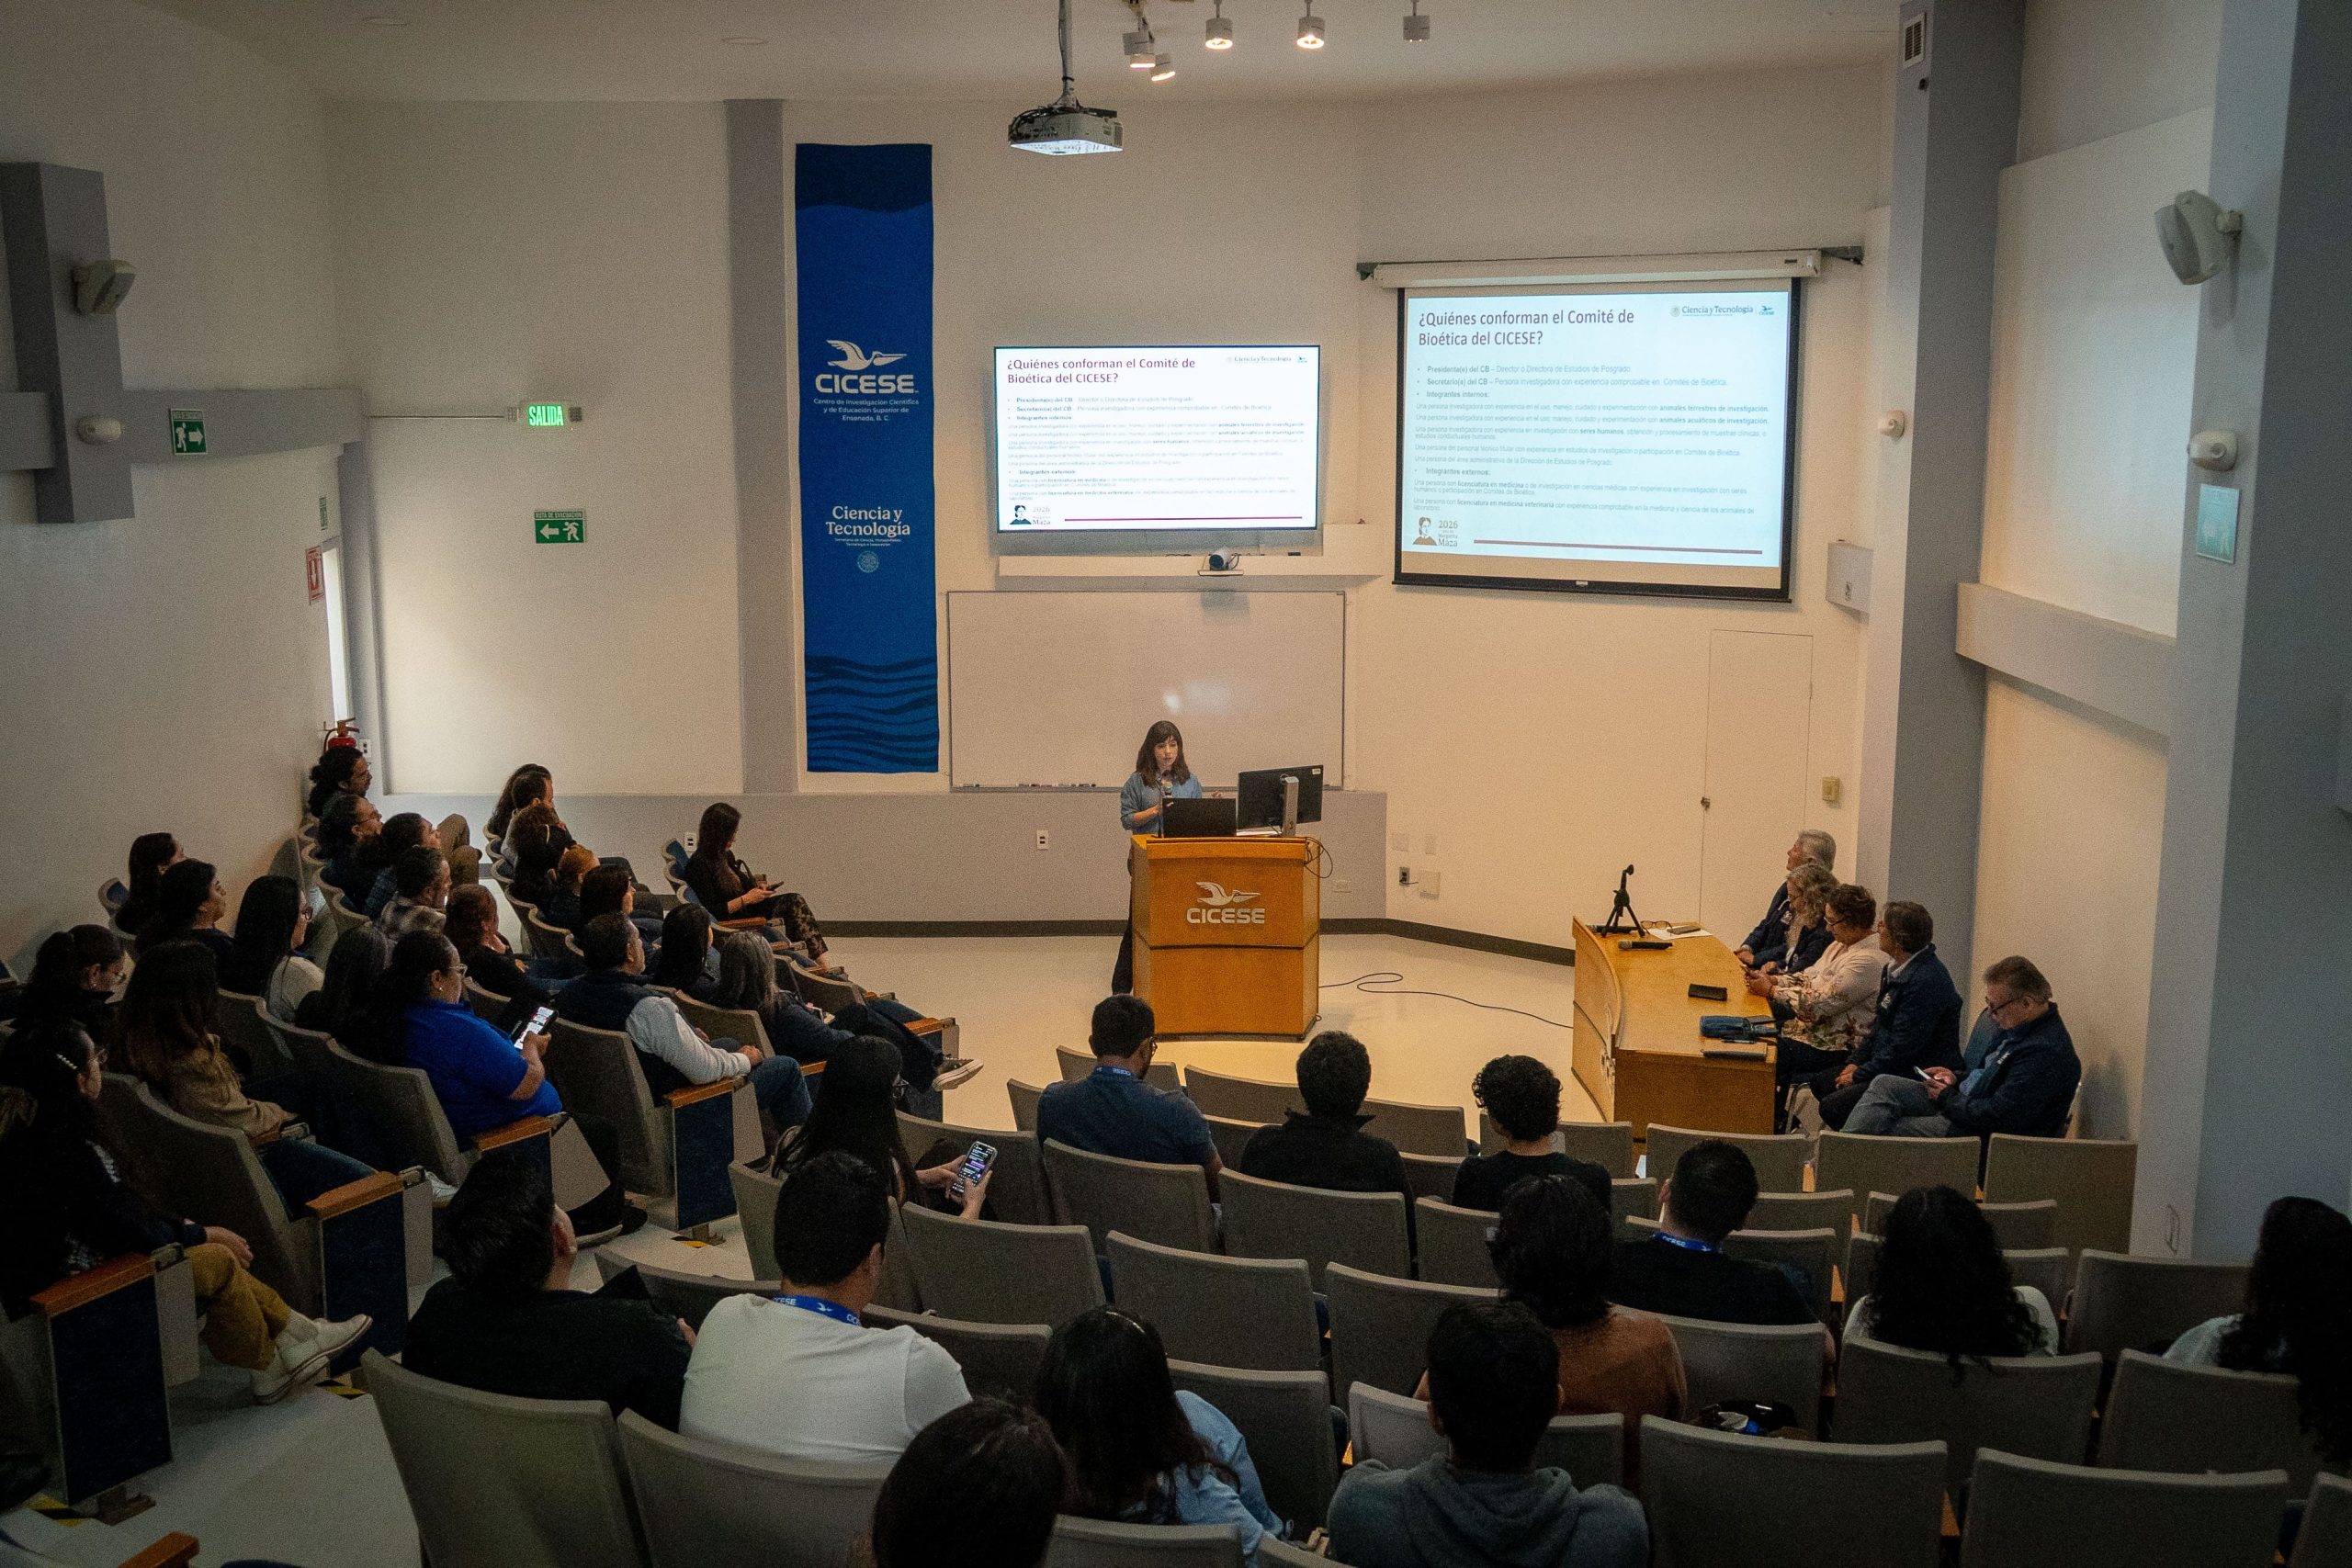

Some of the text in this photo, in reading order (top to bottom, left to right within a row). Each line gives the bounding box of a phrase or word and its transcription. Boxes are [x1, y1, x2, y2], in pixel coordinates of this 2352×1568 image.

[1681, 306, 1708, 314] Ciencia
[1419, 309, 1634, 327] ¿Quiénes conforman el Comité de
[1419, 331, 1543, 345] Bioética del CICESE?
[1007, 358, 1195, 369] ¿Quiénes conforman el Comité de
[815, 374, 914, 394] CICESE
[1008, 373, 1118, 383] Bioética del CICESE?
[528, 405, 564, 426] SALIDA
[832, 506, 902, 523] Ciencia y
[825, 522, 910, 538] Tecnología
[1438, 520, 1458, 529] 2026
[1438, 538, 1458, 547] Maza
[1186, 908, 1265, 924] CICESE
